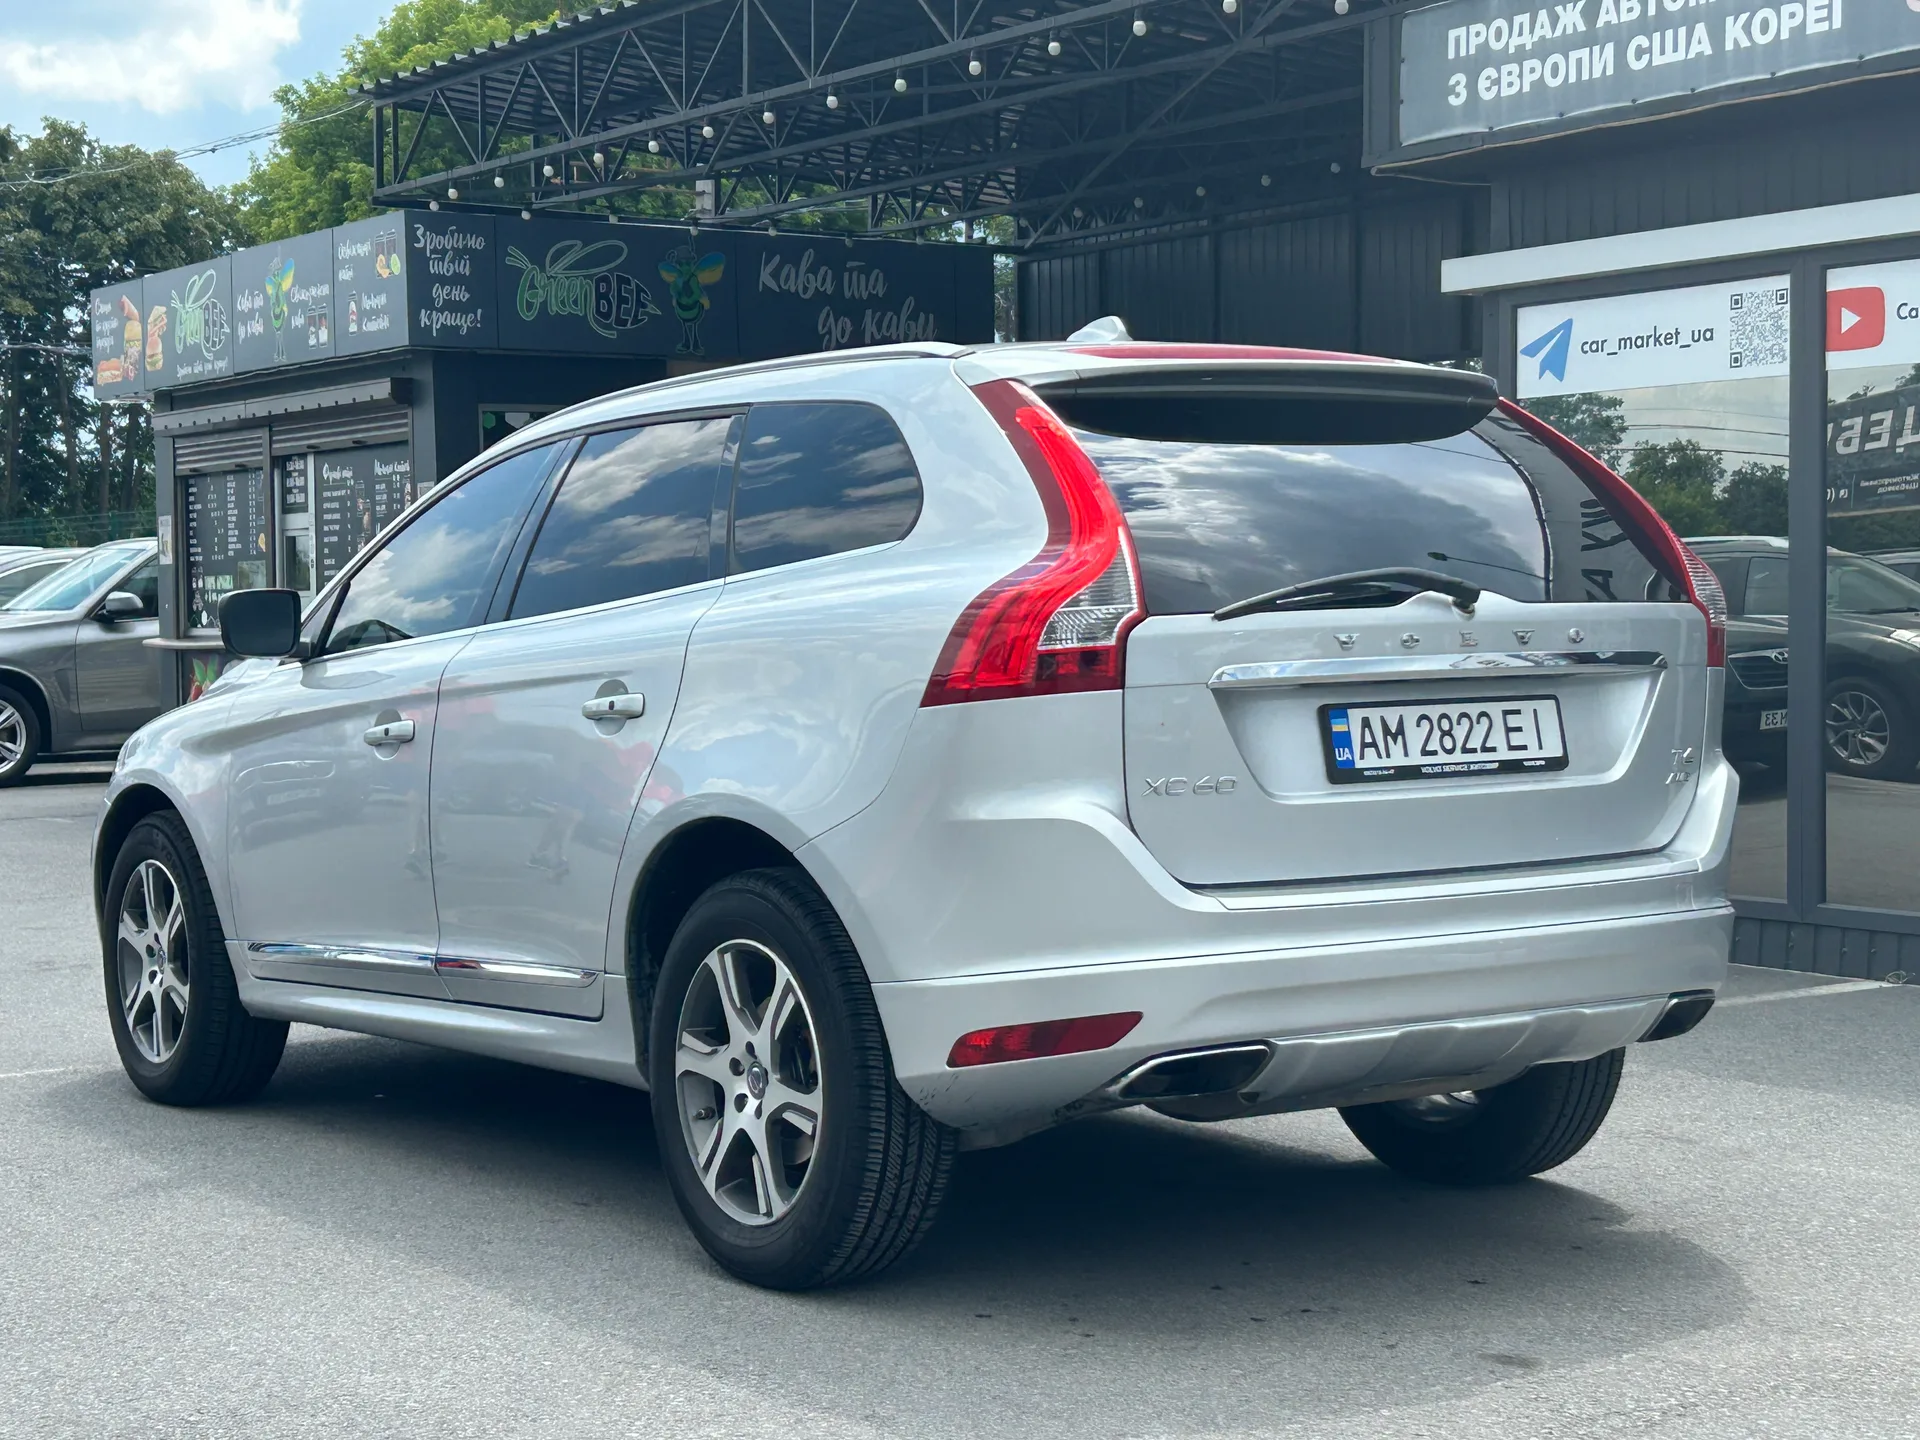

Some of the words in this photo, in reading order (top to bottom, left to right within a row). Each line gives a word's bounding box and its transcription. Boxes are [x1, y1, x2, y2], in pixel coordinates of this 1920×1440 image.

[1448, 0, 1586, 60] ПРОДАЖ
[1447, 73, 1467, 106] З
[1477, 42, 1615, 101] ЄВРОПИ
[1626, 22, 1713, 71] США
[413, 223, 486, 257] Зробимо
[429, 250, 471, 277] твій
[759, 249, 836, 299] Кава
[843, 261, 889, 300] та
[432, 283, 471, 308] день
[419, 308, 483, 337] краще!
[817, 306, 853, 351] до
[861, 296, 938, 344] кави
[1580, 326, 1714, 357] car_market_ua
[1333, 627, 1585, 651] VOLVO
[1359, 714, 1409, 760] AM
[1416, 710, 1498, 757] 2822
[1501, 708, 1543, 752] EI
[1335, 747, 1353, 761] UA
[1142, 775, 1237, 796] XC60
